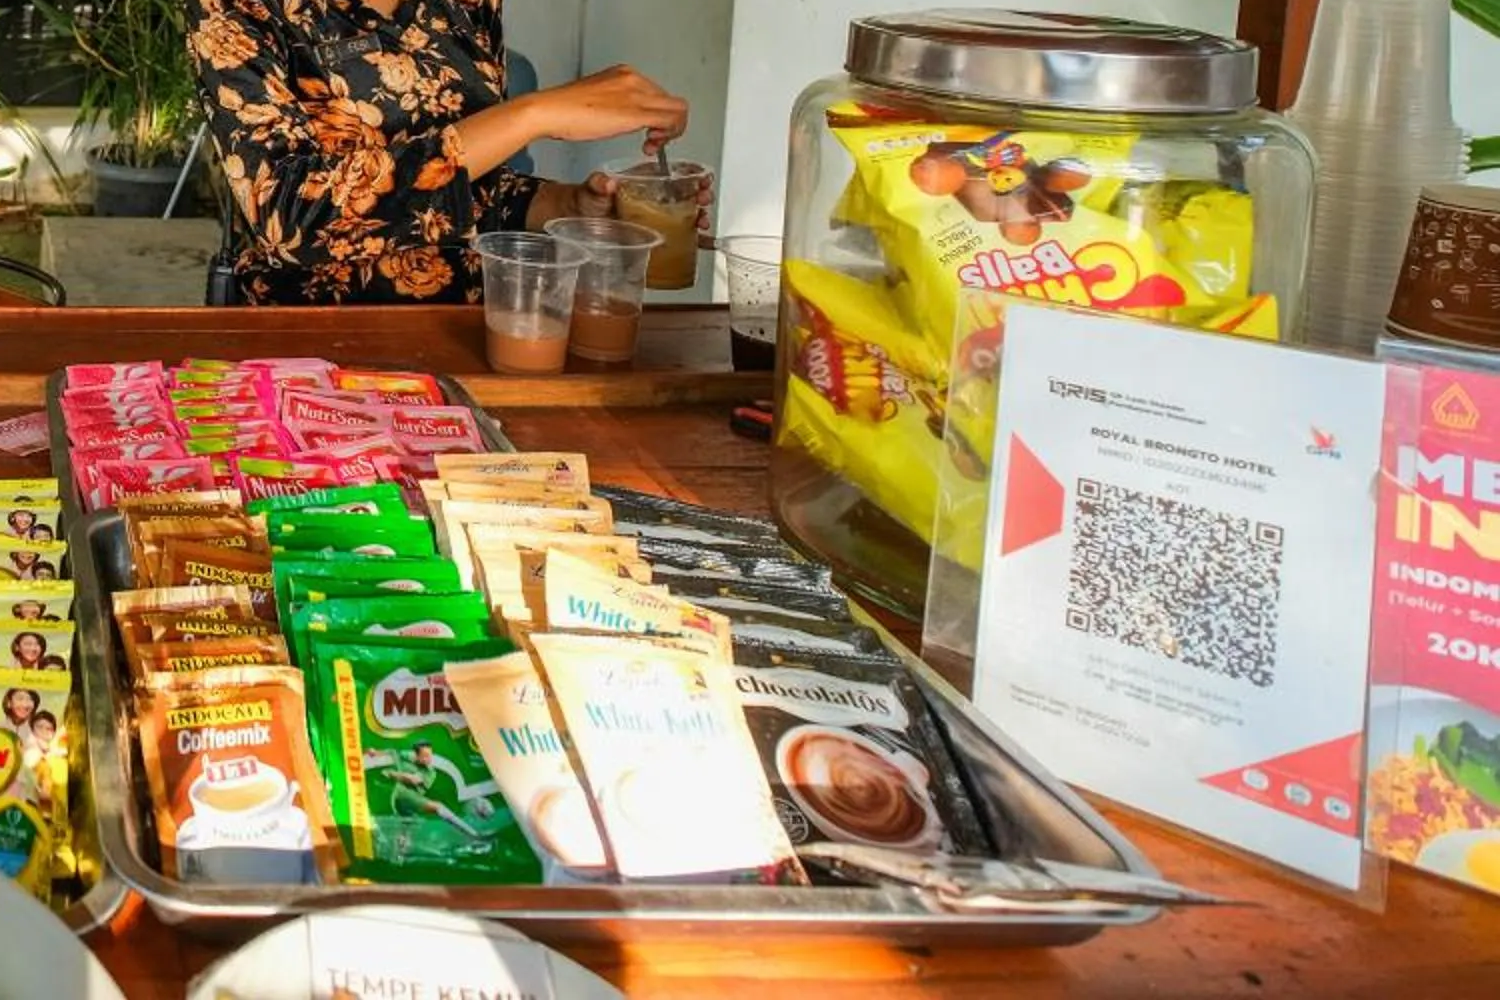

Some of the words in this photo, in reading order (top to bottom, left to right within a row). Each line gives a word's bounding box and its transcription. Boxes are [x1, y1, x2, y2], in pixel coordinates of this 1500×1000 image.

[959, 240, 1076, 289] Balls
[1091, 427, 1139, 446] ROYAL
[1144, 439, 1219, 464] BRONGTO
[1224, 456, 1277, 477] HOTEL
[568, 594, 636, 632] White
[178, 724, 271, 755] Coffeemix
